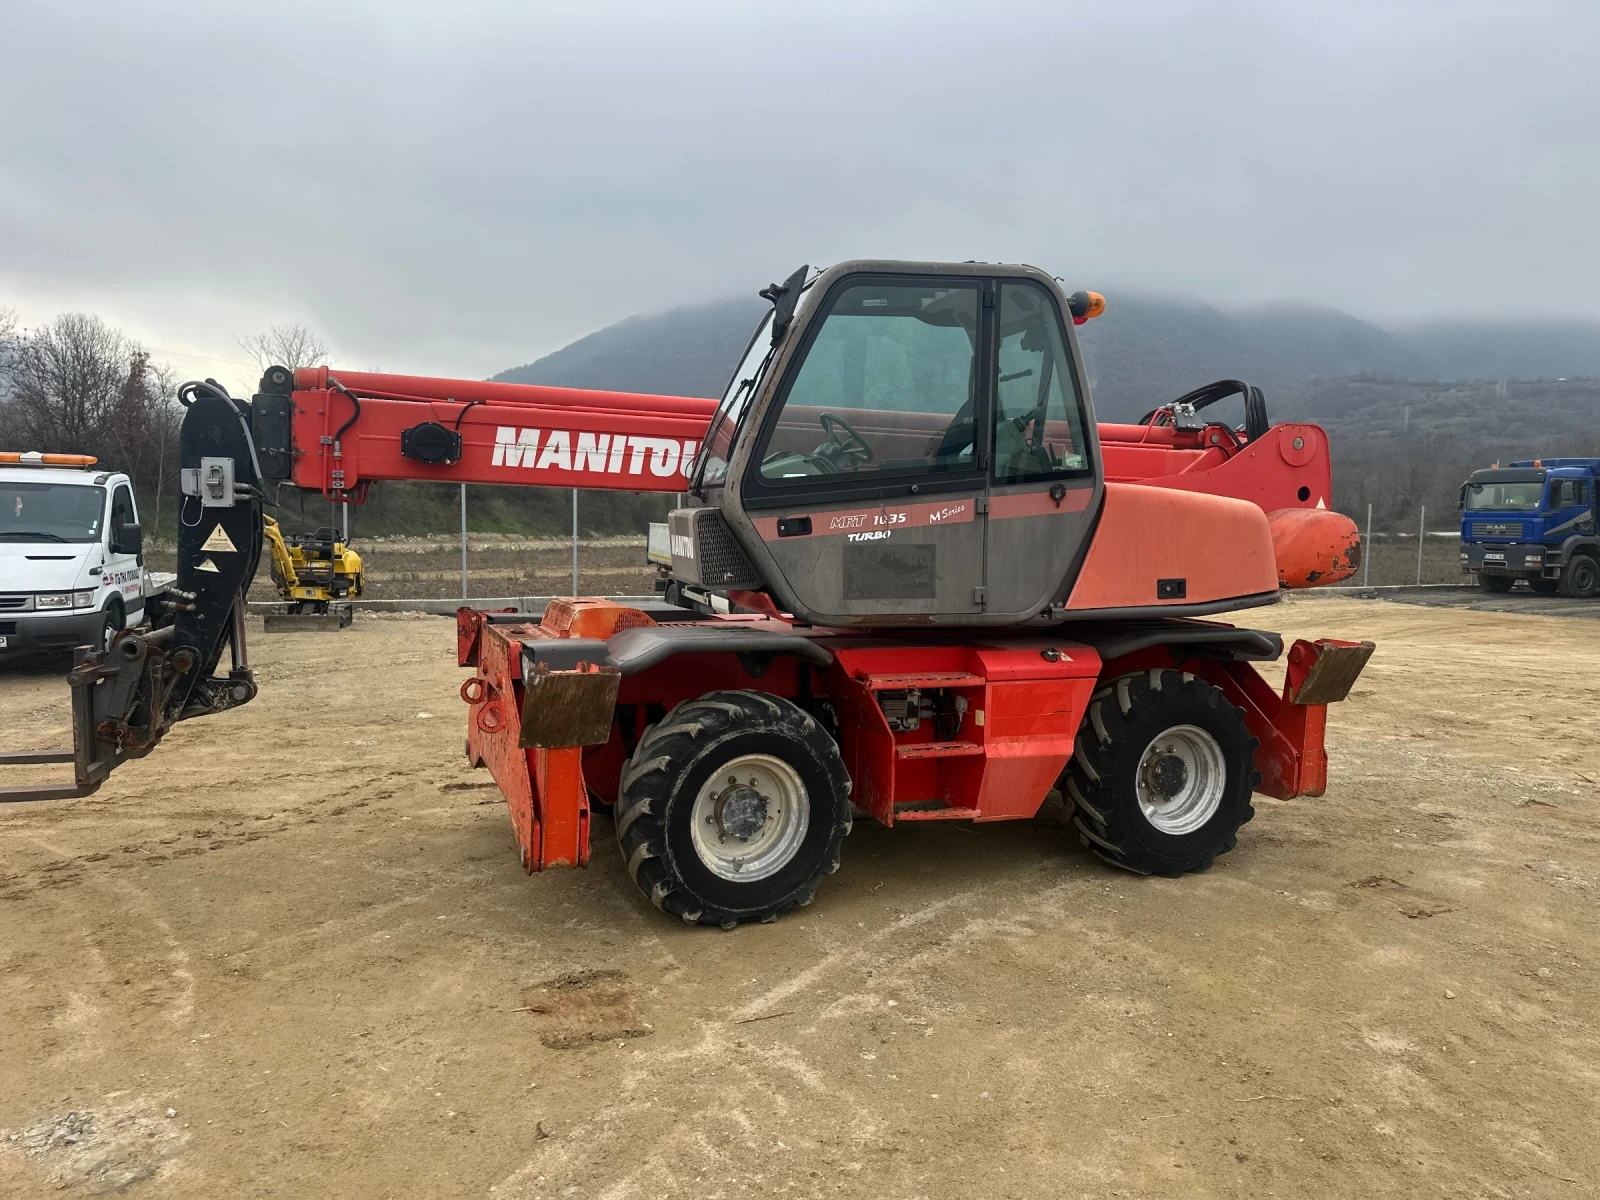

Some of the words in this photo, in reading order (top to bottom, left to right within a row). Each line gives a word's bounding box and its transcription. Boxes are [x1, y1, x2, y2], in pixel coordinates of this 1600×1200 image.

[830, 514, 868, 529] MRT
[929, 511, 941, 524] M
[941, 505, 966, 519] Series
[848, 530, 892, 542] TURBO
